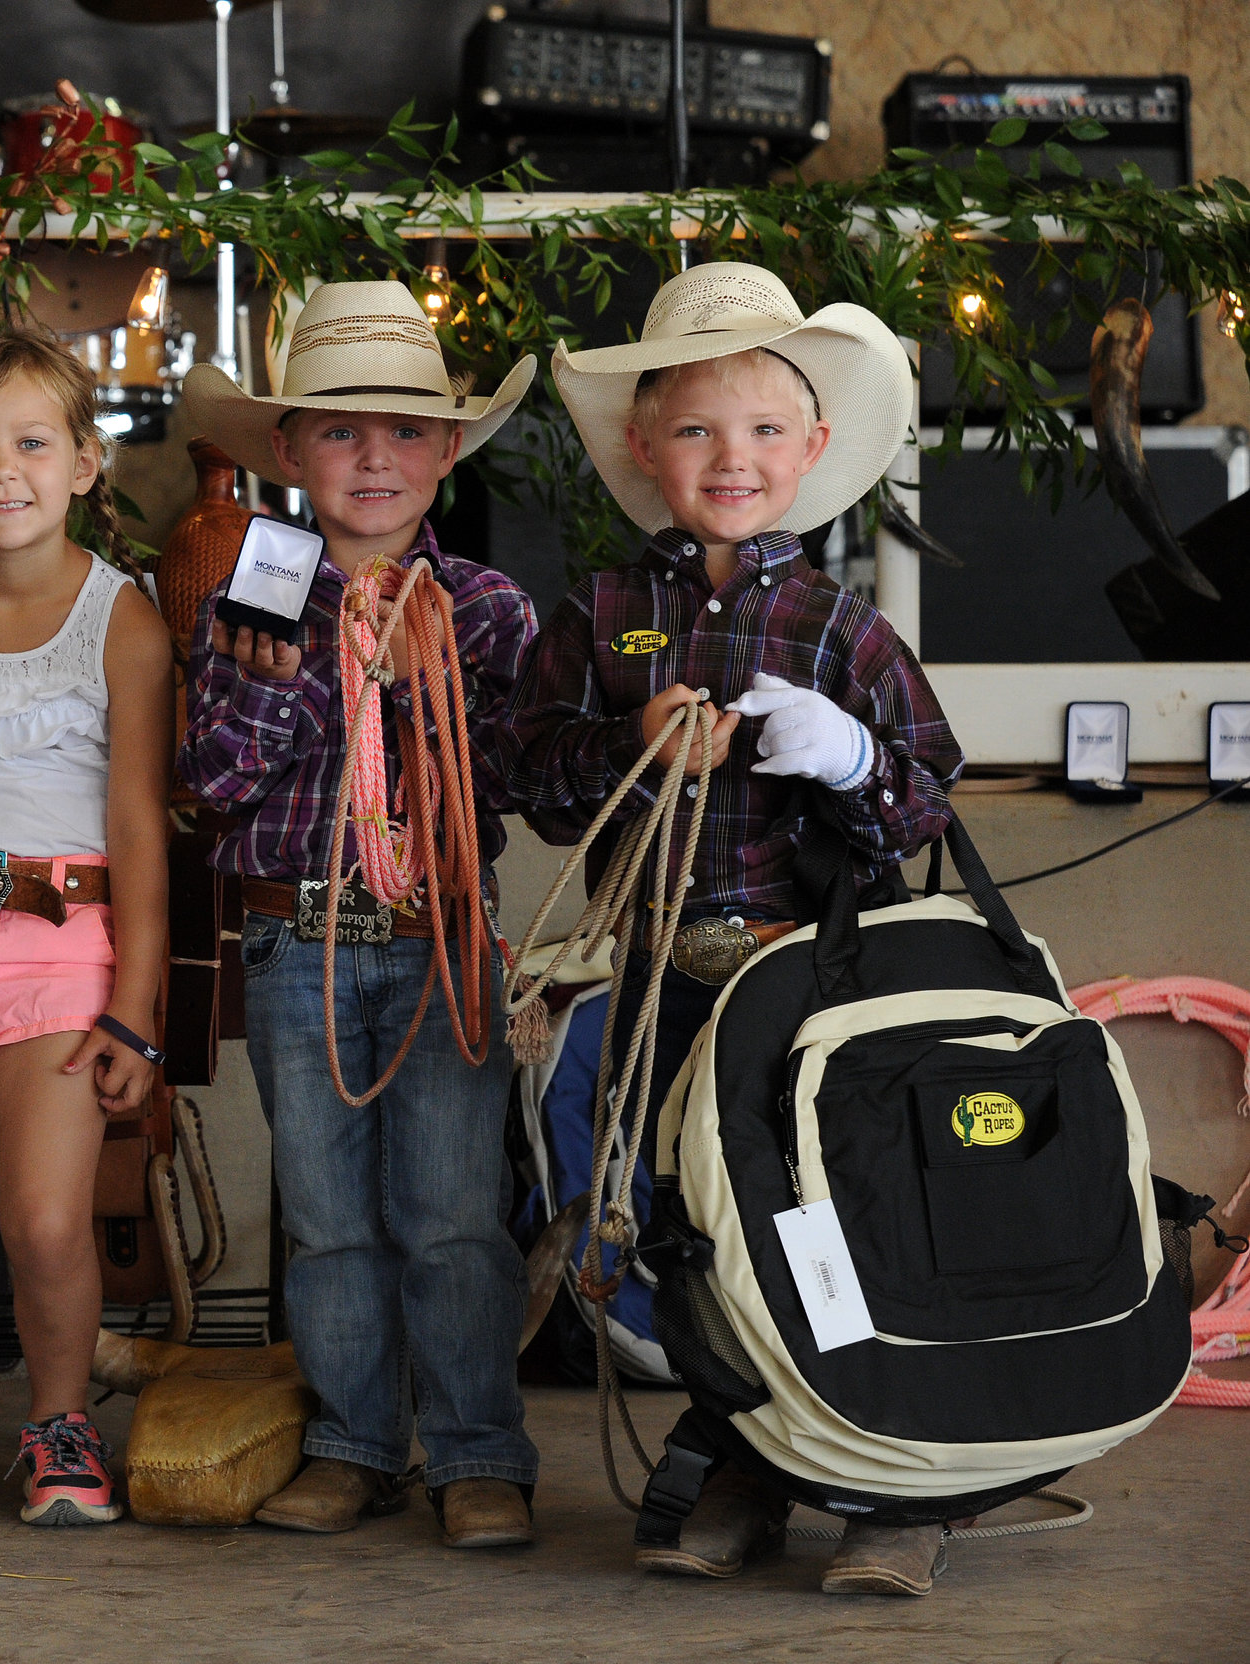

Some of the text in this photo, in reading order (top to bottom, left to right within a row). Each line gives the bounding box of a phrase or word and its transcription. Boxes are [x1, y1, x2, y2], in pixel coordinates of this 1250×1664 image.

[254, 560, 301, 579] MONTANA
[627, 634, 662, 644] CACTUS
[634, 642, 661, 652] ROPES
[313, 911, 375, 931] CHMPION
[336, 927, 359, 943] 013
[973, 1101, 1013, 1117] CACTUS
[983, 1118, 1014, 1134] ROPES
